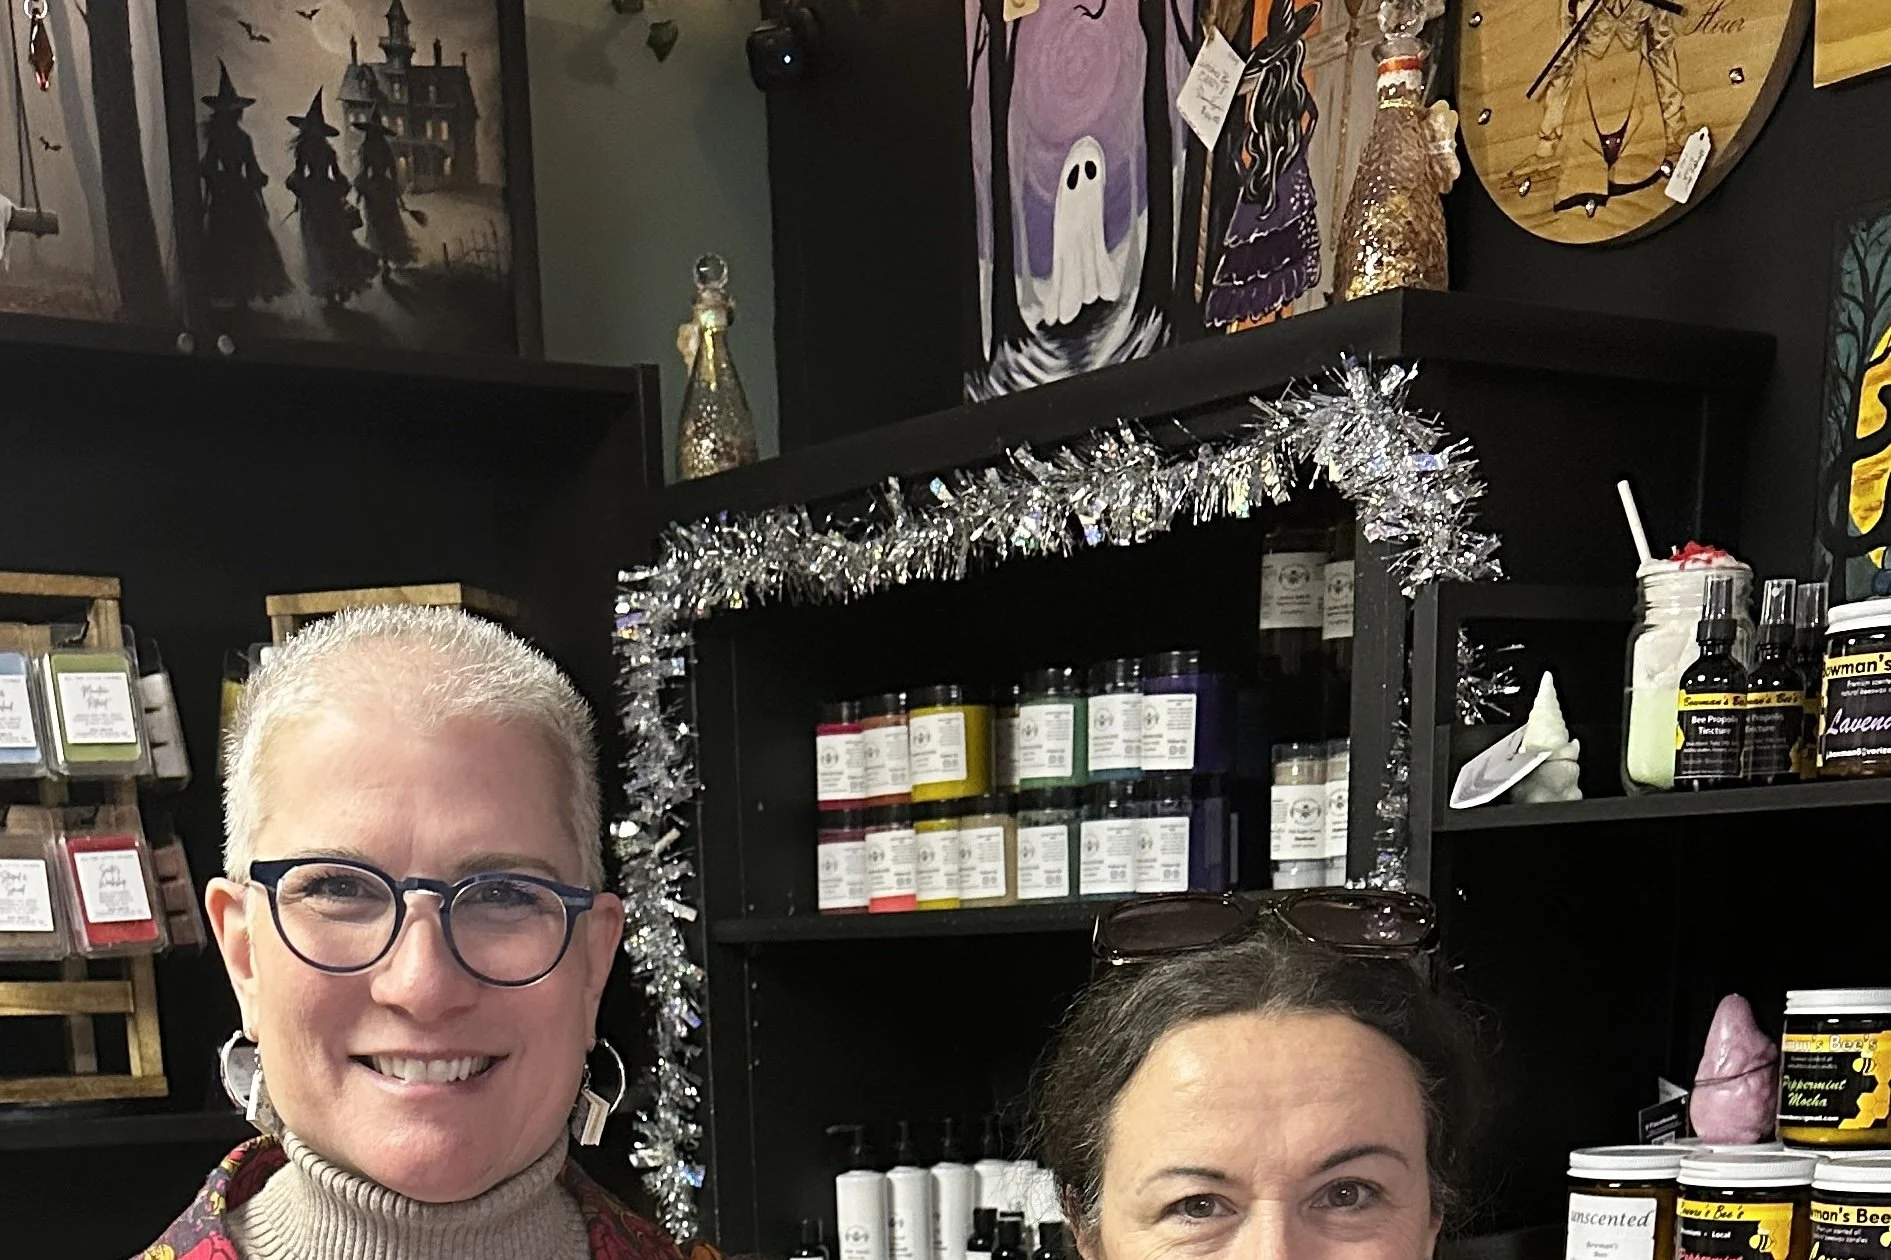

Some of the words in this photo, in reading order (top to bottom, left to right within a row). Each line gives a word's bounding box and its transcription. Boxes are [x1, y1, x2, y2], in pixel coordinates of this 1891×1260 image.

[1691, 716, 1706, 724] Bee
[1829, 1034, 1878, 1051] Bee's
[1788, 1091, 1828, 1107] Mocha
[1711, 1229, 1732, 1239] Local
